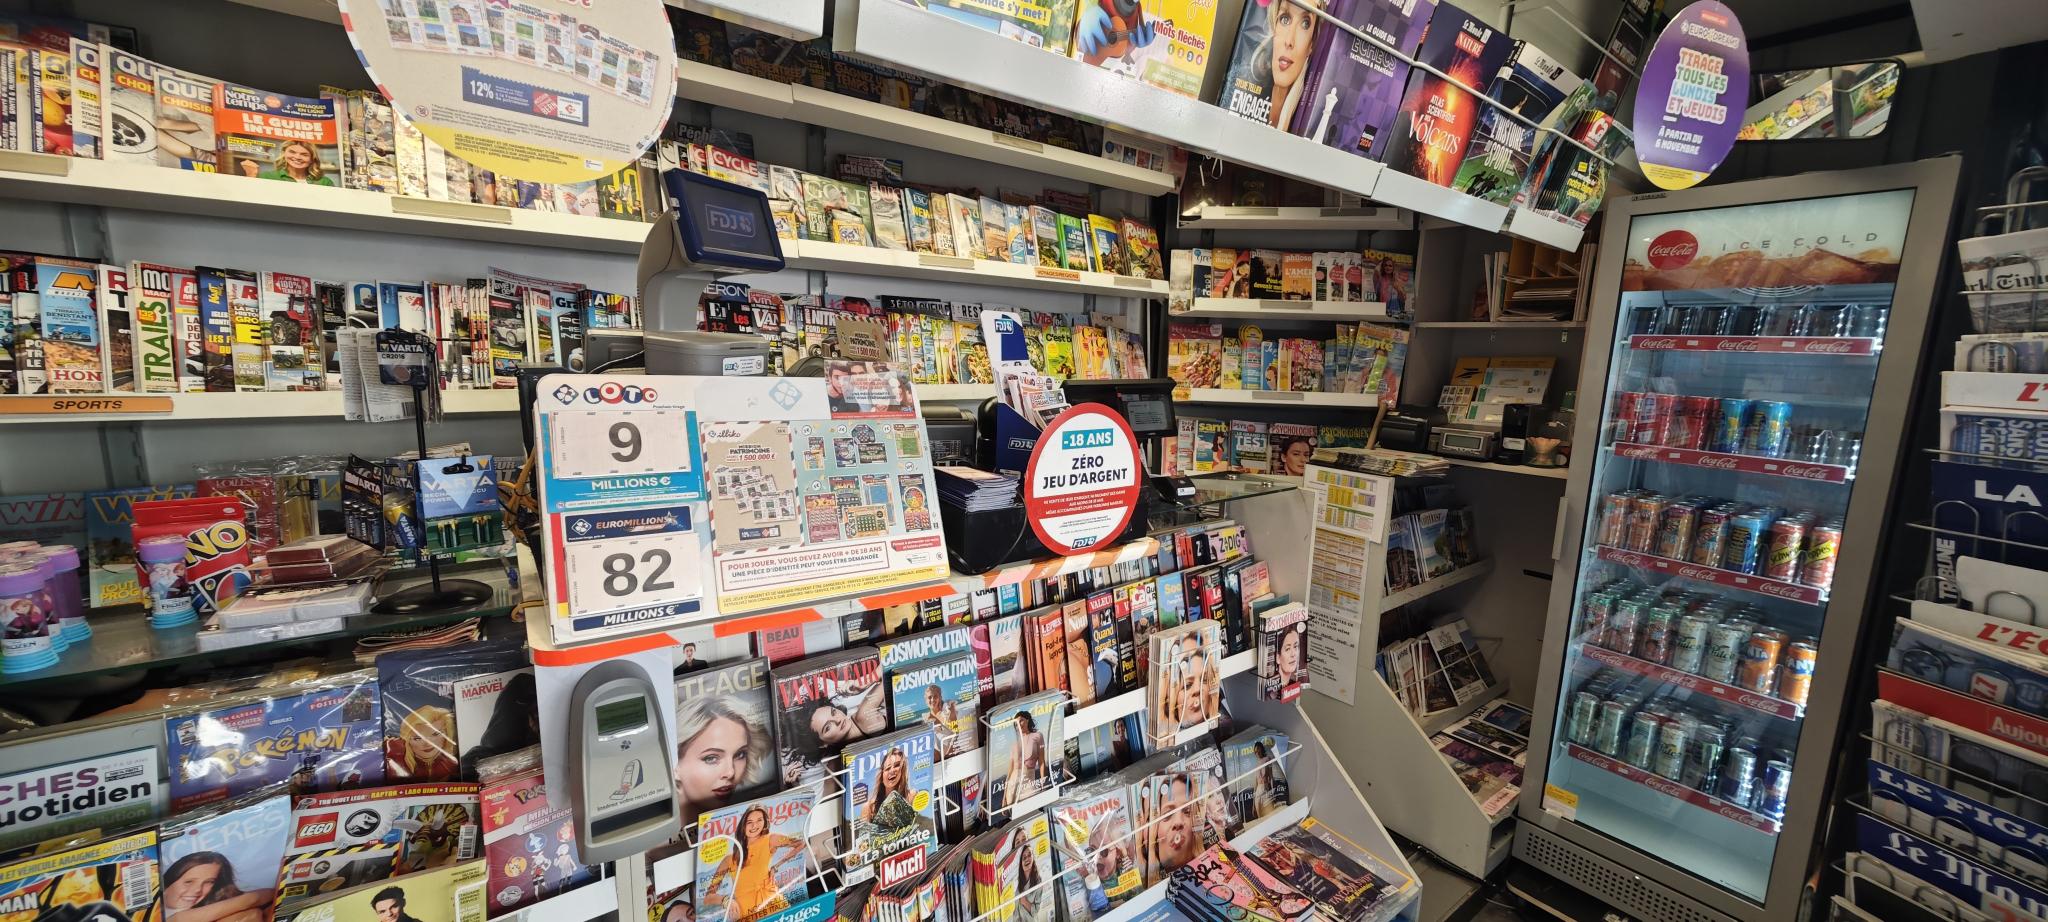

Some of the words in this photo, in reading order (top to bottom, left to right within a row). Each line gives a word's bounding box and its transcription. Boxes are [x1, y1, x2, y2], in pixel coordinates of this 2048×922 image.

[1154, 22, 1177, 40] Mots
[1373, 27, 1387, 40] GUIDE
[1456, 32, 1486, 58] NATURE
[1679, 49, 1722, 76] TIRAGE
[469, 79, 495, 100] 12%
[1676, 65, 1705, 86] TOUS
[1706, 75, 1728, 92] LES
[161, 79, 212, 103] QUE
[225, 90, 261, 105] Notre
[1430, 94, 1445, 108] ATLAS
[1672, 82, 1716, 105] LUNDIS
[225, 97, 269, 112] temps
[1229, 88, 1273, 123] ENGAGÉE
[1667, 98, 1682, 114] ET
[1683, 101, 1727, 123] JEUDIS
[242, 112, 265, 125] LE
[268, 116, 323, 132] GUIDE
[244, 124, 324, 141] INTERNET
[1409, 110, 1462, 155] Volcans
[1661, 139, 1701, 156] NOVEMBRE
[713, 151, 759, 177] CYCLE
[1722, 239, 1772, 251] ICE
[1793, 231, 1879, 247] COLD
[141, 300, 175, 381] TRAILS
[390, 342, 424, 353] VARTA
[583, 382, 658, 405] LOTO
[53, 399, 123, 411] SPORTS
[1063, 433, 1085, 447] -18
[1086, 431, 1112, 446] ANS
[1270, 424, 1317, 437] PSYCHOLOGIES
[608, 421, 642, 463] 9
[729, 447, 771, 455] PATRIMOINE
[1071, 453, 1104, 470] ZÉRO
[384, 473, 414, 490] VARTA
[422, 475, 495, 492] VARTA
[591, 476, 659, 491] MILLIONS
[1042, 474, 1066, 490] JEU
[1069, 468, 1128, 487] D'ARGENT
[1974, 479, 2043, 508] LA
[595, 515, 668, 530] EUROMILLIONS
[727, 561, 750, 571] POUR
[751, 560, 776, 570] JOUER,
[777, 556, 798, 565] VOUS
[798, 553, 821, 562] DEVEZ
[823, 550, 844, 560] AVOIR
[869, 545, 883, 554] ANS
[731, 569, 746, 578] UNE
[746, 566, 765, 577] PIÈCE
[765, 562, 799, 574] D'IDENTITÉ
[800, 562, 816, 571] PEUT
[816, 559, 833, 568] VOUS
[833, 556, 849, 566] ÊTRE
[849, 553, 880, 564] DEMANDÉE
[602, 548, 675, 597] 82
[603, 605, 665, 626] MILLIONS
[1265, 607, 1308, 632] PSYCHOLOGIES
[881, 627, 972, 668] COSMOPOLITAN
[778, 667, 842, 710] VANITY
[845, 651, 883, 694] FAIR
[894, 652, 978, 693] COSMOPOLITAN
[461, 681, 505, 699] MARVEL
[370, 790, 398, 799] RAPTOR
[449, 786, 469, 794] CARTE
[1876, 767, 1934, 802] LE
[299, 821, 337, 838] LEGO
[863, 846, 880, 866] La
[881, 828, 931, 855] tomate
[883, 844, 925, 886] MATCH
[1188, 860, 1223, 889] 2024
